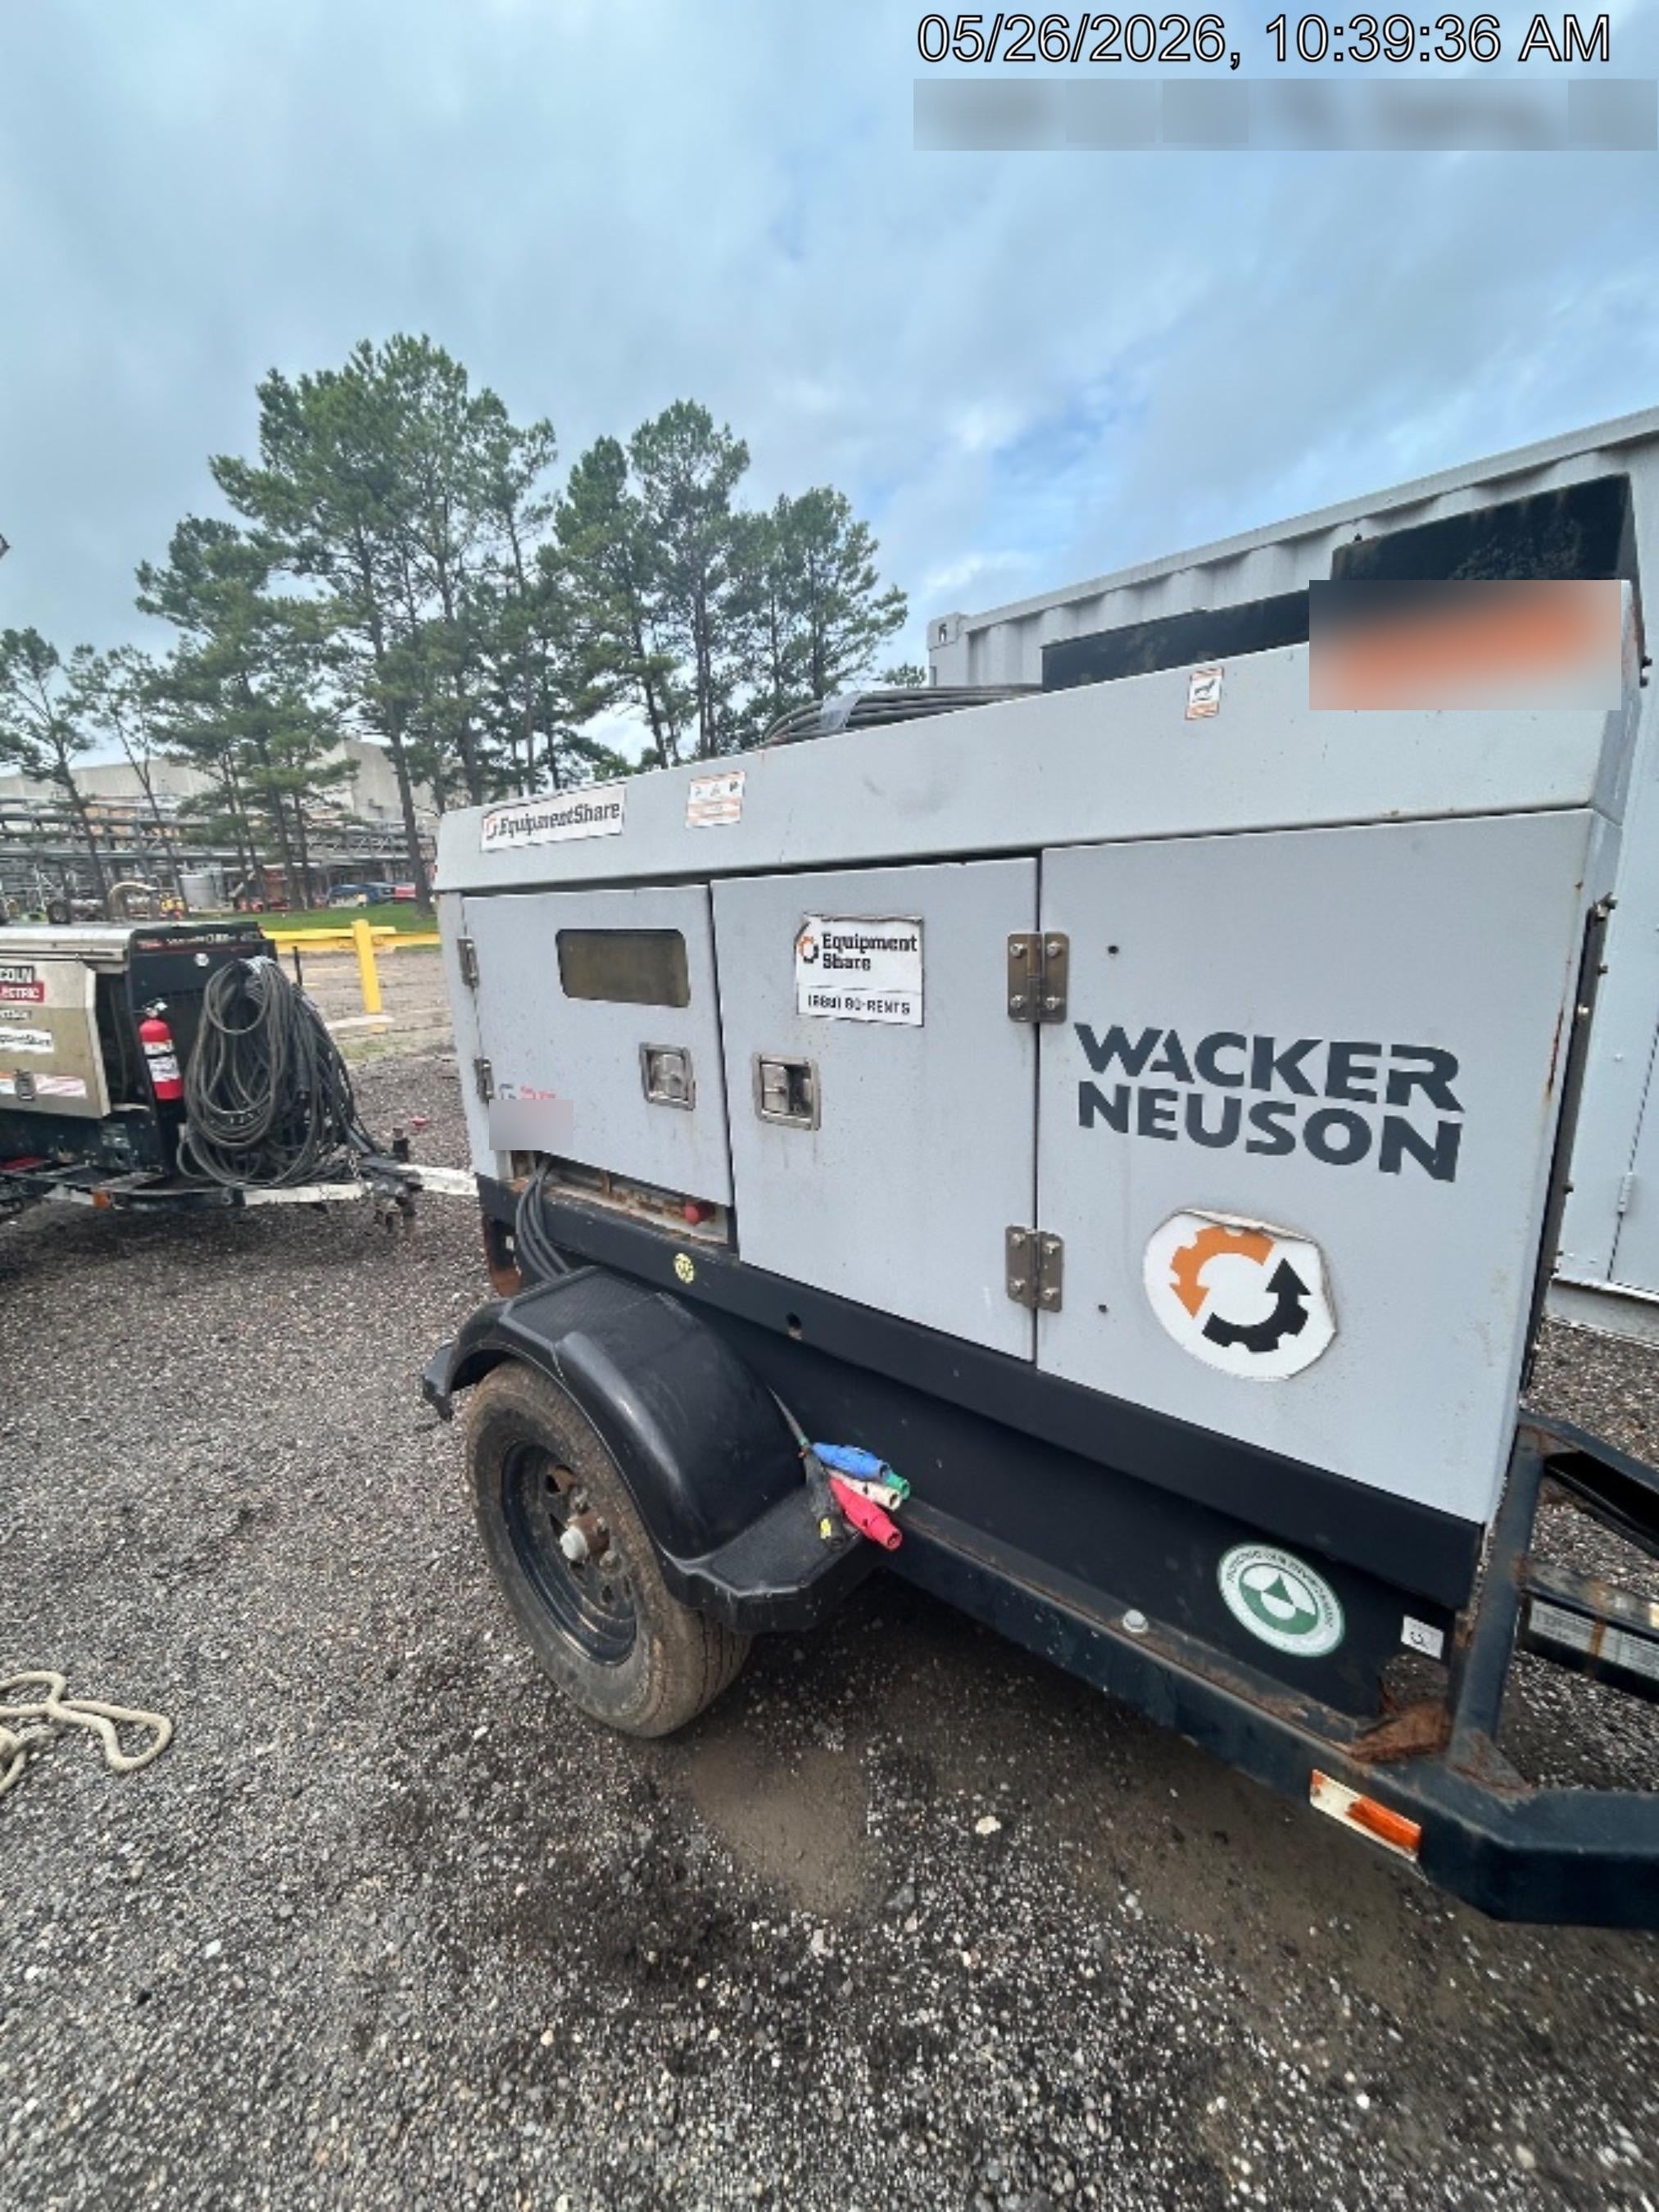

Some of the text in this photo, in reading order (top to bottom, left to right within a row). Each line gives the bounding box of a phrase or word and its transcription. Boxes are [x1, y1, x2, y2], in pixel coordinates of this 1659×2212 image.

[498, 802, 620, 836] EquipmentShare
[822, 932, 918, 954] Equipment
[823, 953, 871, 971] Share
[1074, 1022, 1465, 1113] WACKER
[1078, 1081, 1462, 1182] NEUSON
